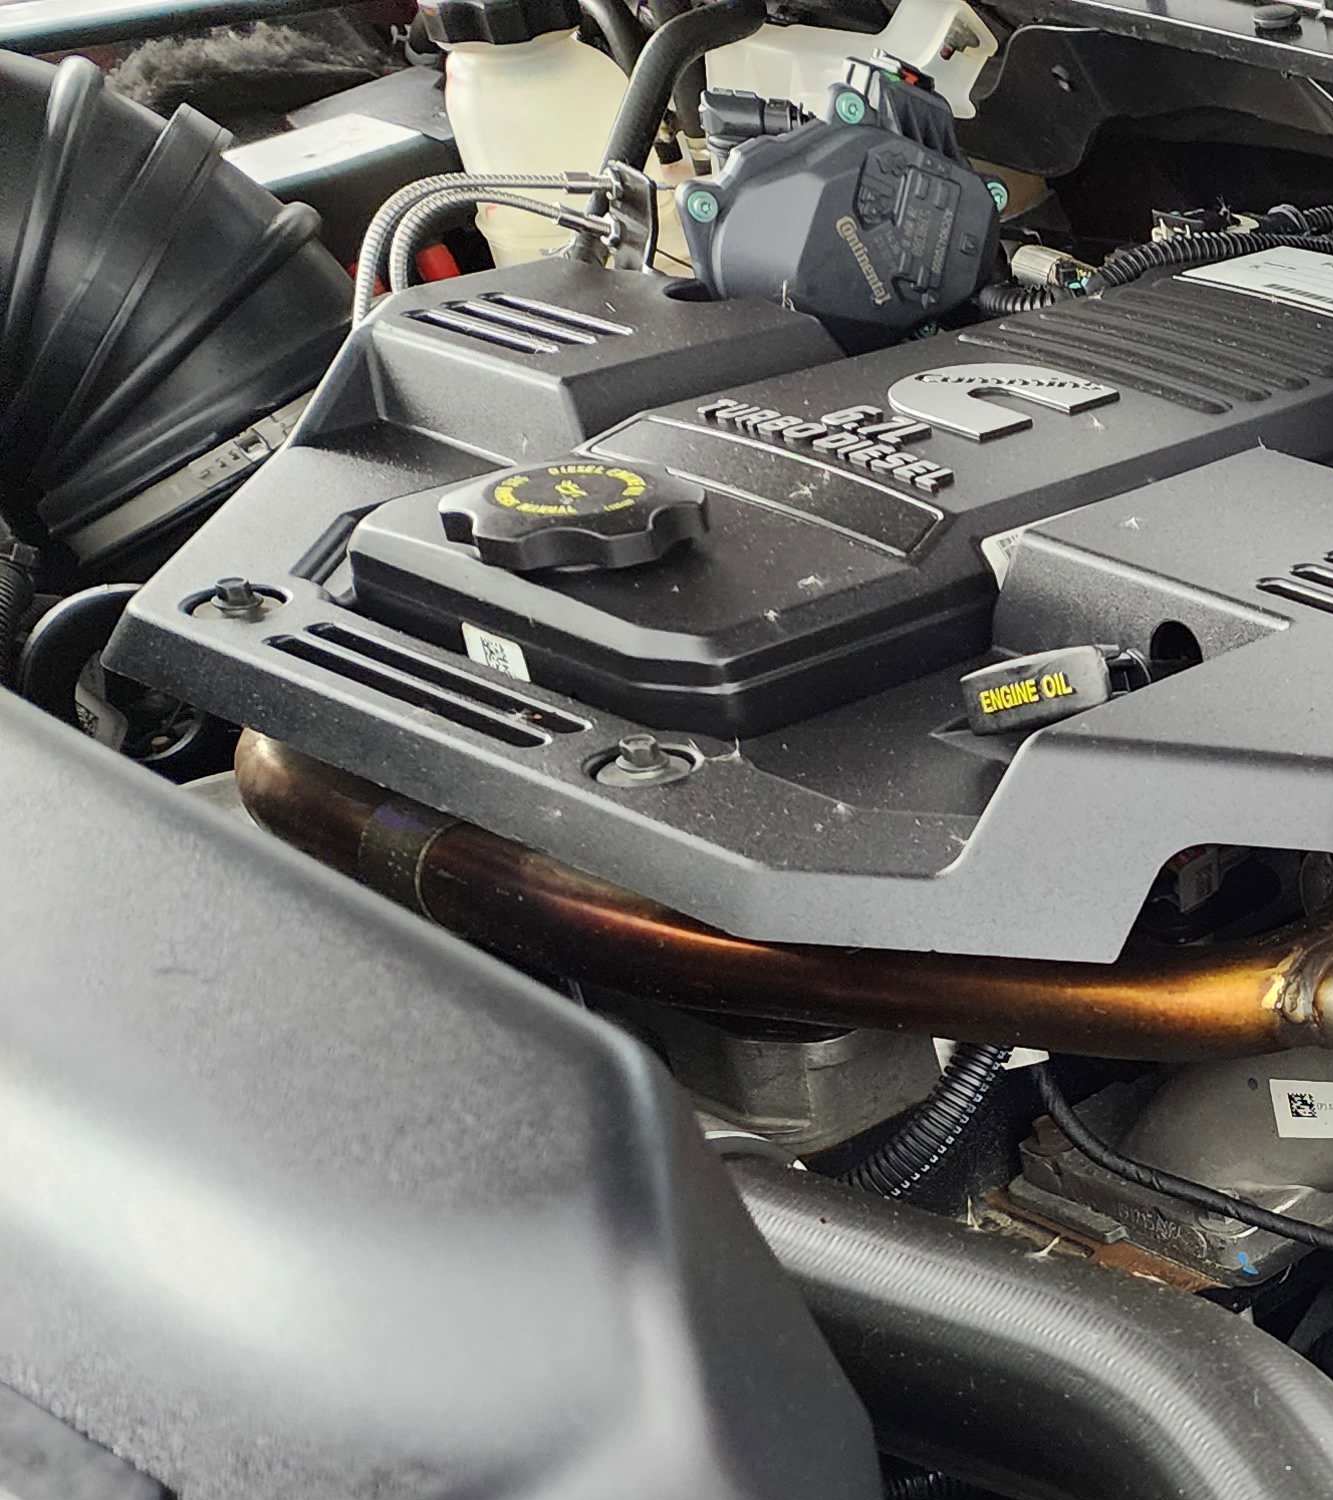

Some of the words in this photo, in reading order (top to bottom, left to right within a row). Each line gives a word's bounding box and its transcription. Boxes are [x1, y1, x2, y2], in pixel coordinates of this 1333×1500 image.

[836, 216, 891, 305] Continental
[914, 373, 1106, 391] Cummins
[821, 404, 932, 443] 6.7L
[697, 398, 828, 445] TURBO
[812, 430, 954, 496] DIESEL
[980, 678, 1040, 713] ENGINE
[1041, 671, 1074, 699] OIL
